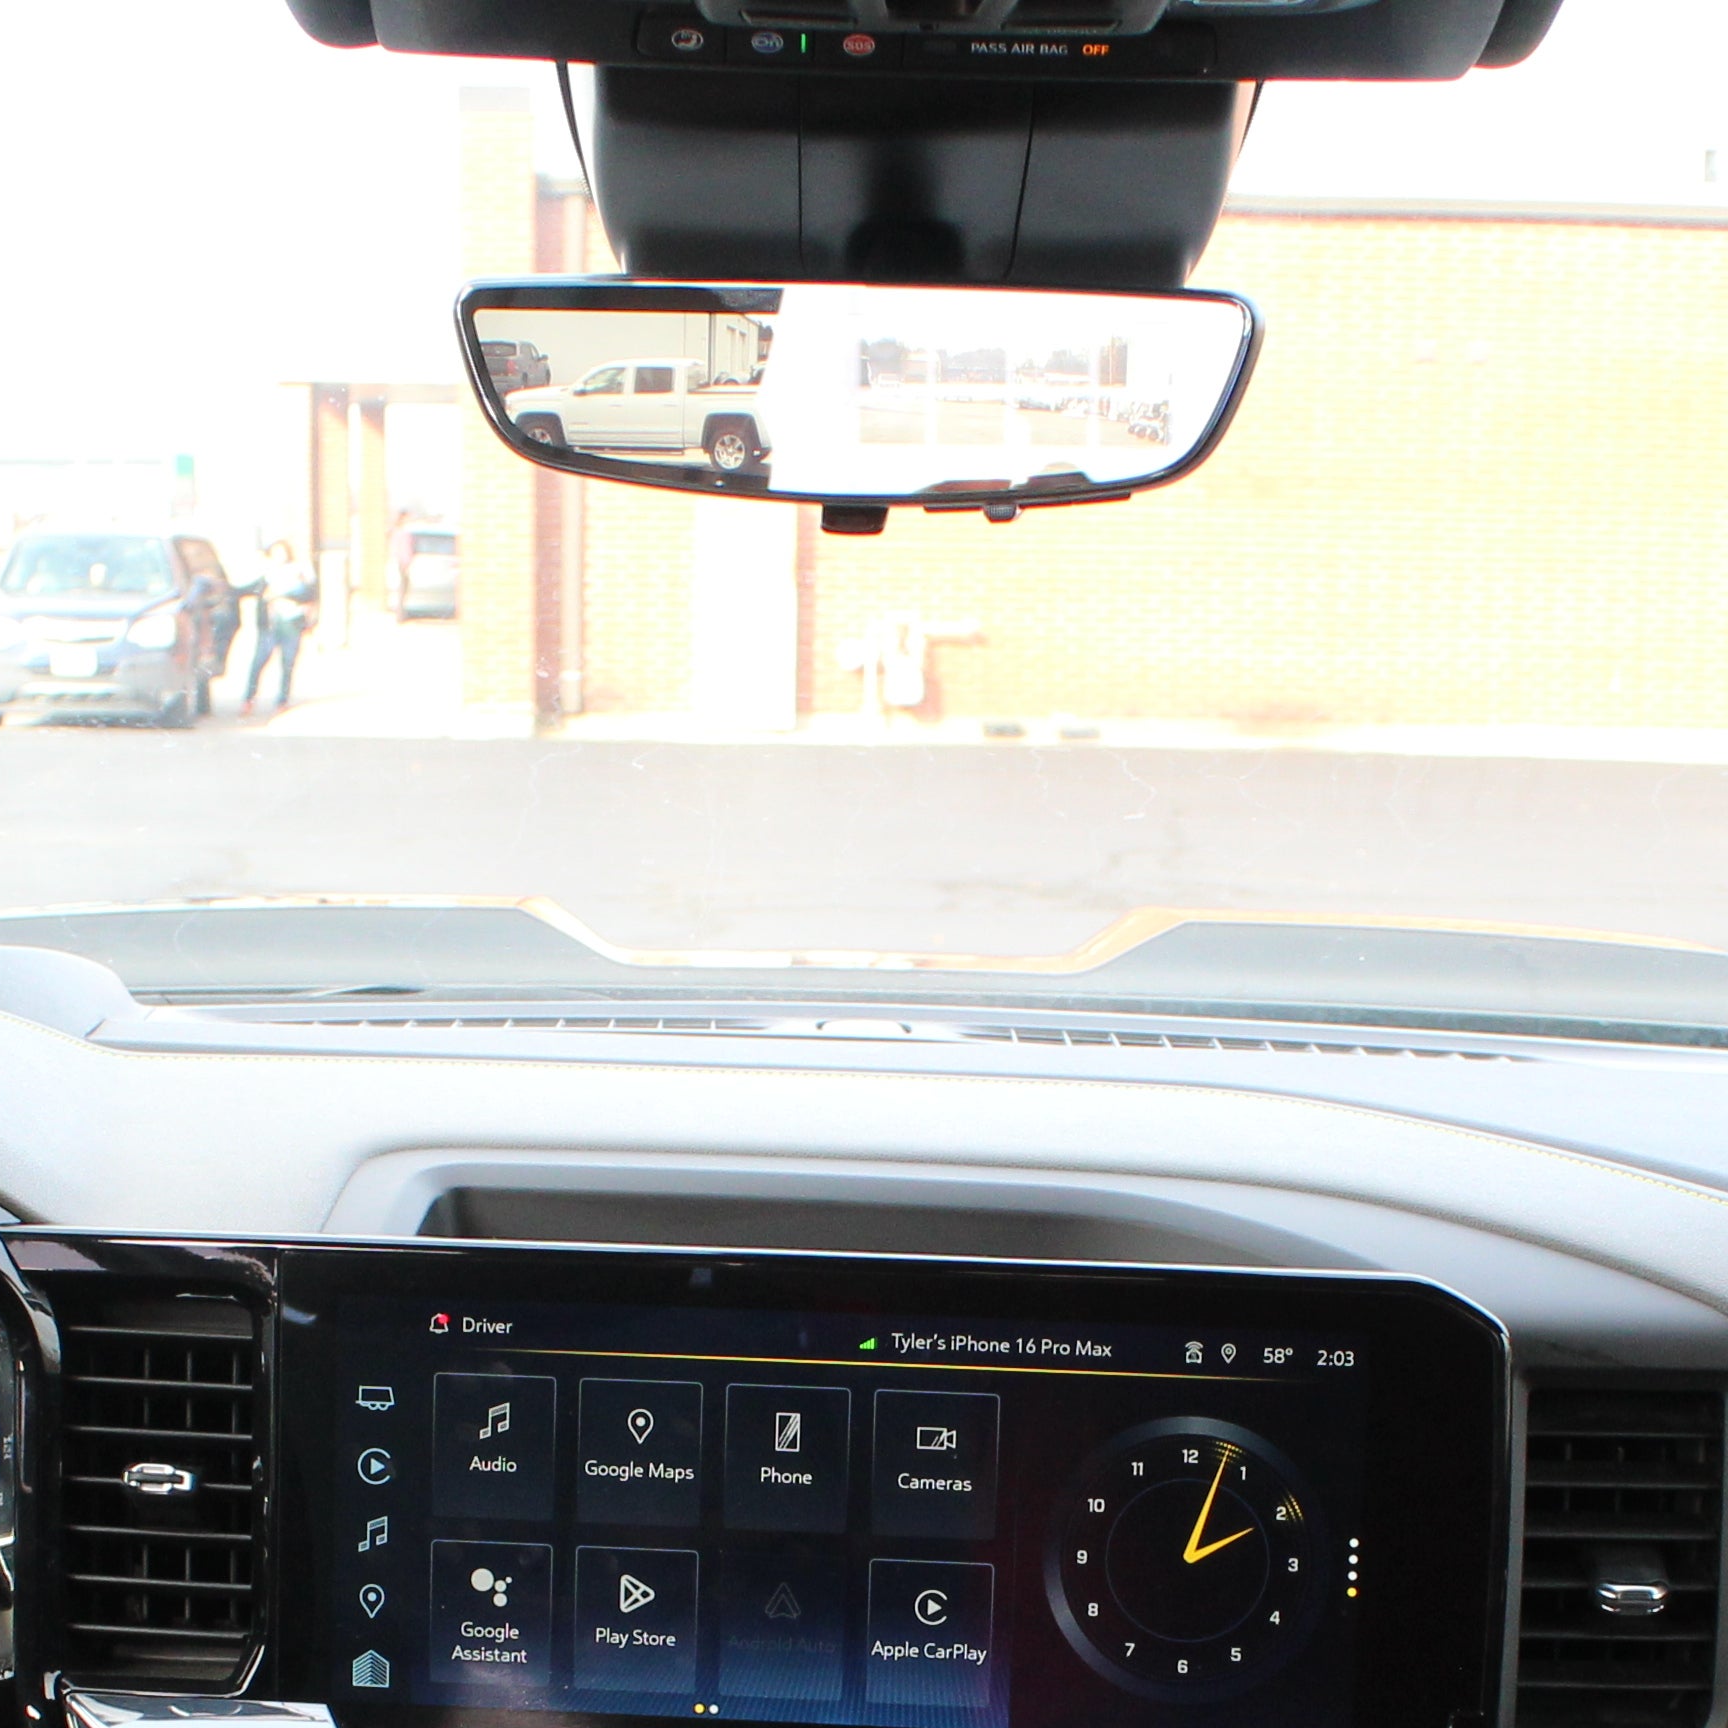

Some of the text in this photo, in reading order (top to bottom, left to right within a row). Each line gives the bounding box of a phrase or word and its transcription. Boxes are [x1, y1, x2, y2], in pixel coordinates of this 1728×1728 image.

[971, 42, 1109, 55] PASS AIR BAG OFF
[462, 1316, 512, 1334] Driver
[891, 1333, 1112, 1357] Tyler's iPhone 16 Pro Max
[1317, 1350, 1355, 1366] 2:03
[1182, 1449, 1199, 1464] 12
[469, 1456, 517, 1473] Audio
[584, 1460, 694, 1483] Google Maps
[1131, 1462, 1144, 1476] 11
[760, 1467, 812, 1484] Phone
[1239, 1466, 1247, 1480] 1
[897, 1473, 972, 1491] Cameras
[1087, 1498, 1105, 1513] 10
[1275, 1506, 1287, 1520] 2
[1076, 1550, 1088, 1564] 9
[1287, 1557, 1299, 1572] 3
[1087, 1602, 1099, 1616] 8
[1269, 1610, 1280, 1625] 4
[460, 1621, 519, 1643] Google
[595, 1627, 676, 1649] Play Store
[451, 1645, 527, 1664] Assistant
[871, 1640, 987, 1665] Apple CarPlay
[1124, 1643, 1135, 1657] 7
[1230, 1647, 1242, 1661] 5
[1177, 1660, 1188, 1674] 6
